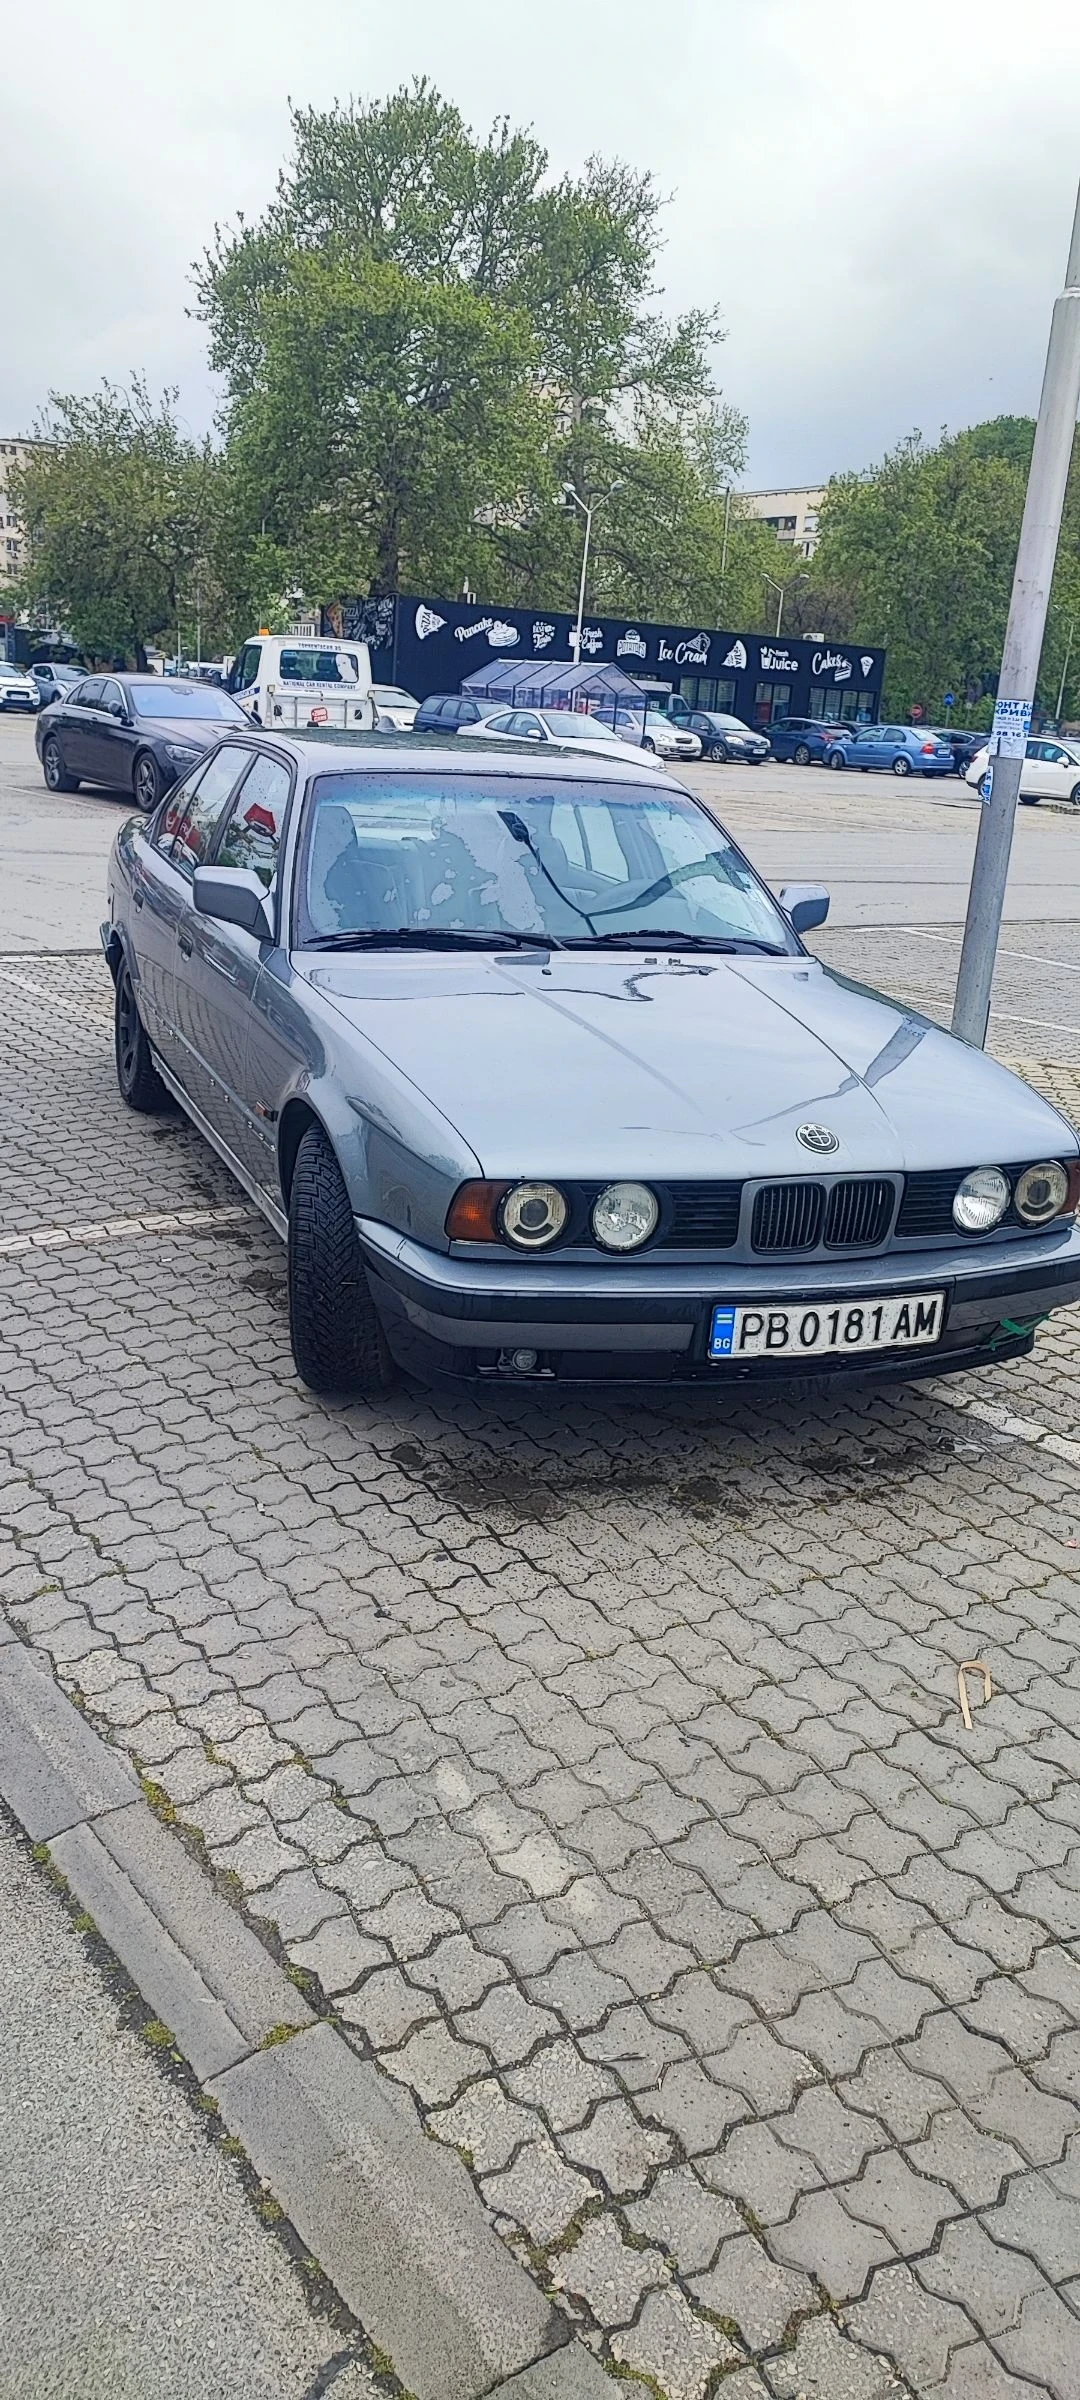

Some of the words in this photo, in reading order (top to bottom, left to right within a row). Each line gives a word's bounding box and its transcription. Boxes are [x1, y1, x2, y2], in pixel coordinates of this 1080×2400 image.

[454, 617, 493, 642] Pancake
[657, 639, 674, 661] Ice
[675, 642, 708, 666] Cream
[770, 656, 799, 671] Juice
[812, 650, 842, 675] Cakes
[739, 1312, 790, 1350] PB
[799, 1305, 884, 1347] 0181
[891, 1300, 938, 1340] AM
[713, 1337, 731, 1350] BG
